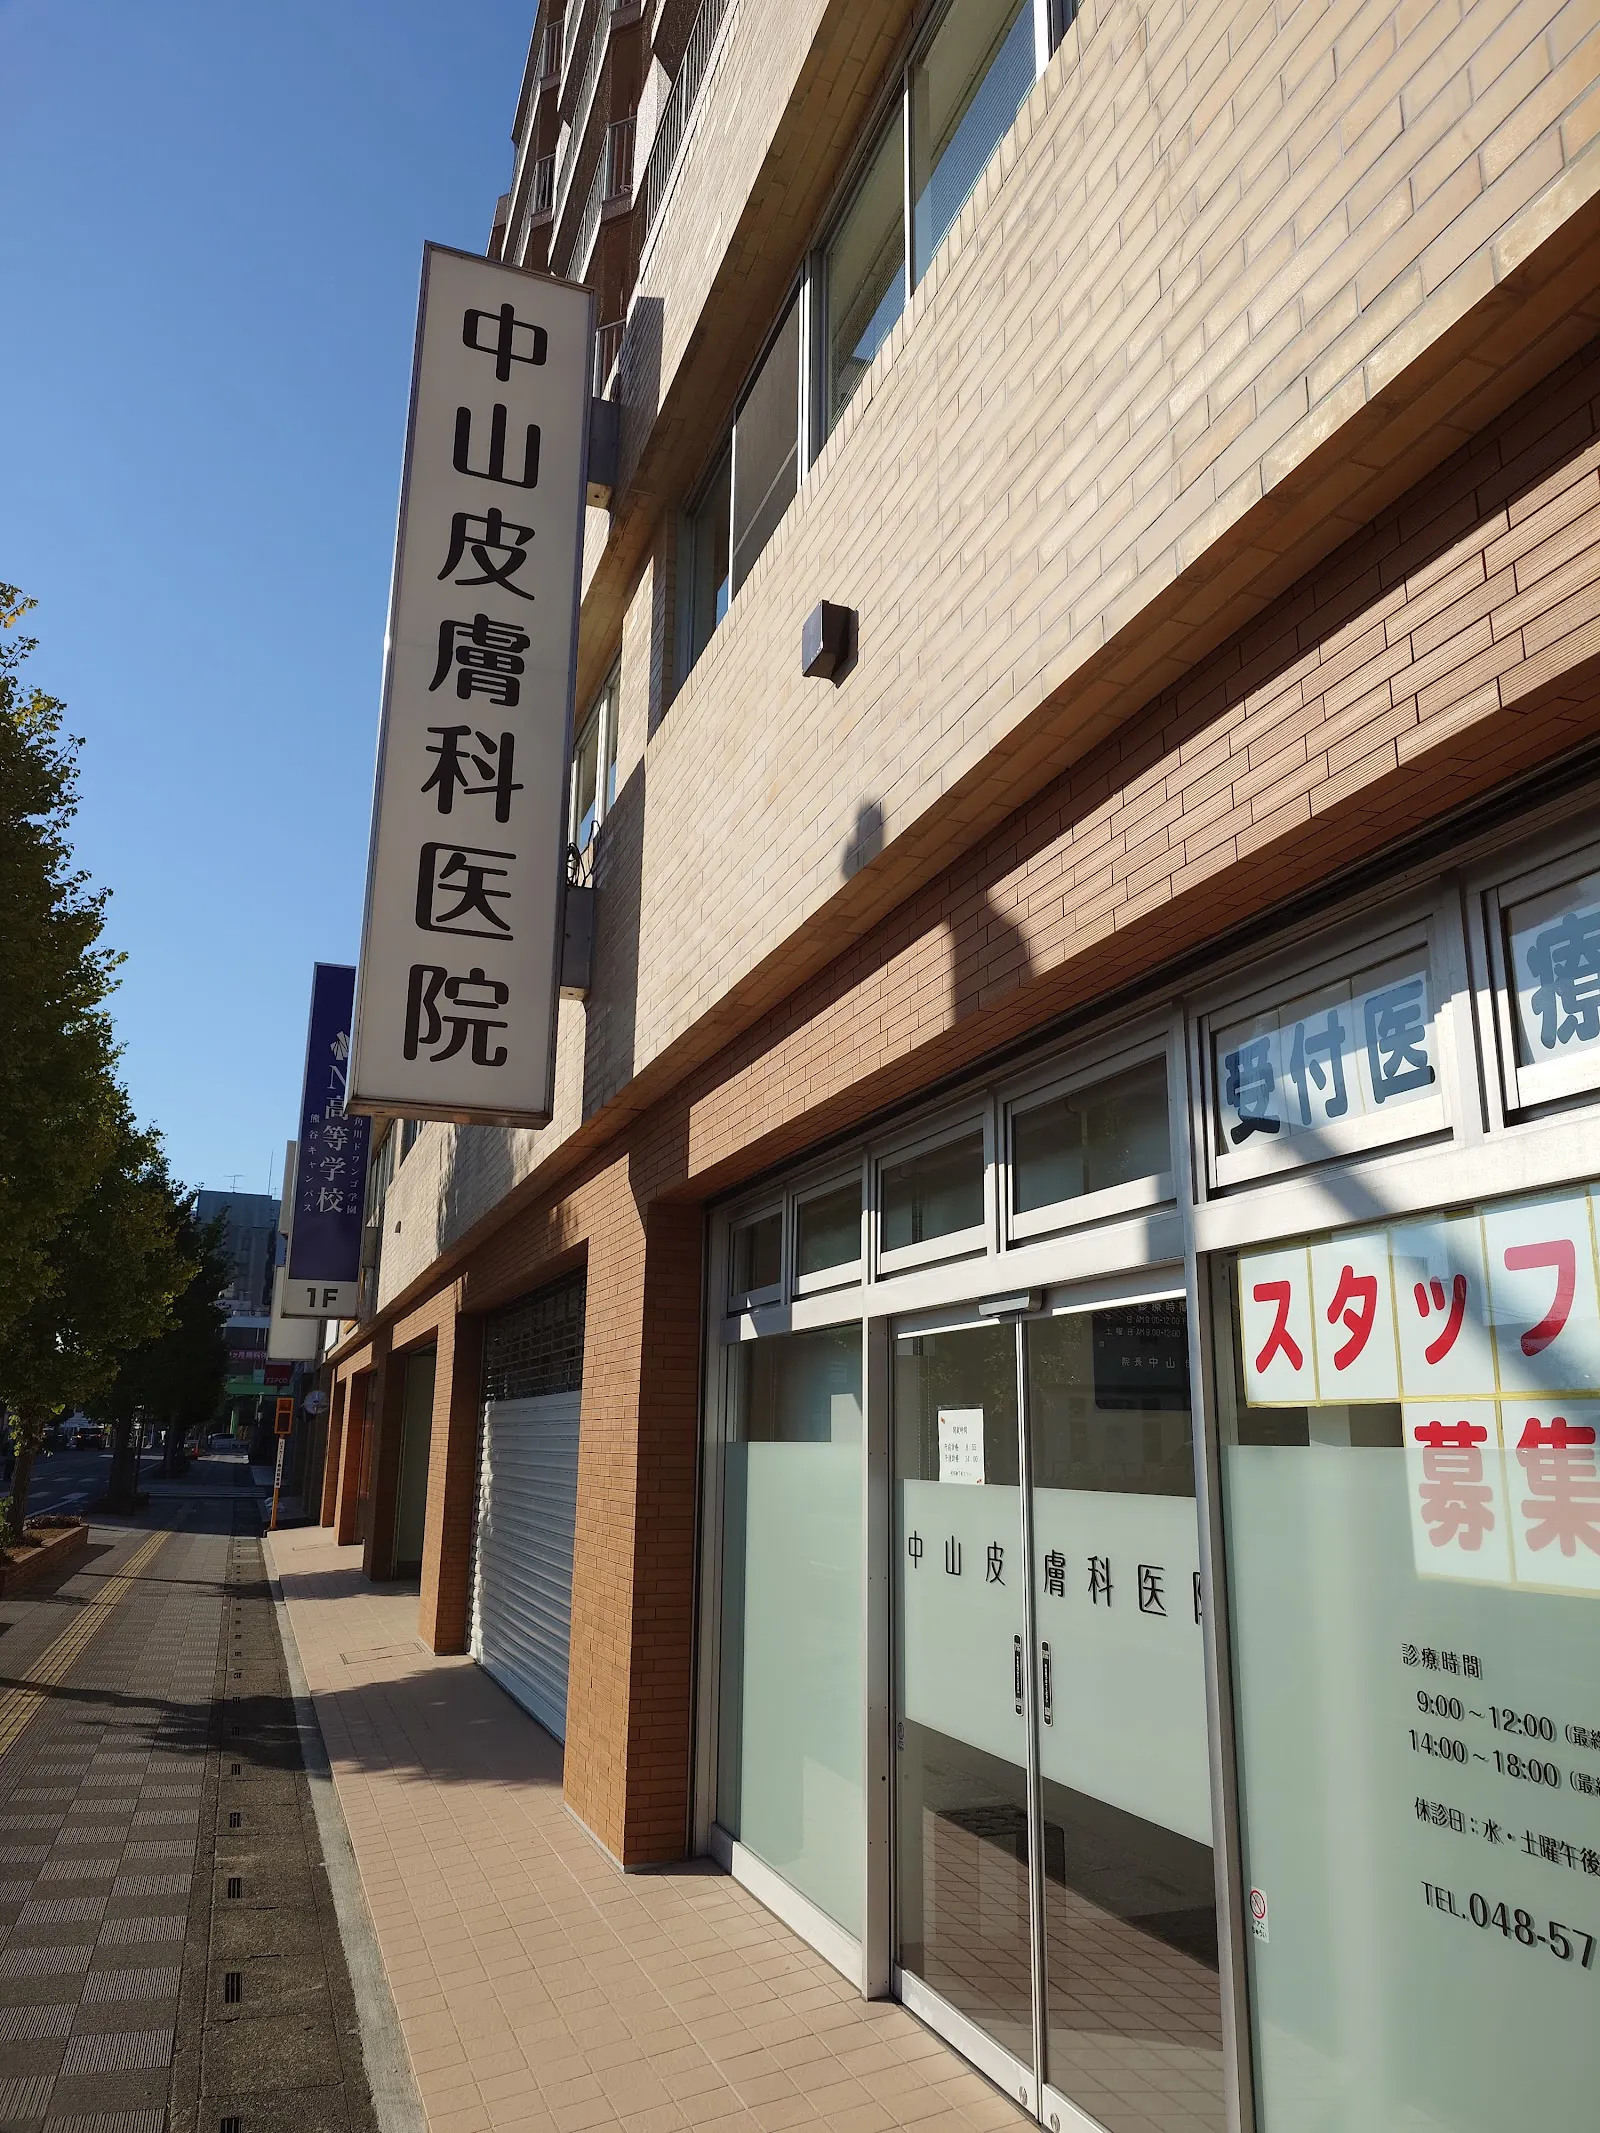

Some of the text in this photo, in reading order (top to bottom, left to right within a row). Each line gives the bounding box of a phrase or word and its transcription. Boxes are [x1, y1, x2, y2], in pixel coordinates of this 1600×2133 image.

[403, 303, 548, 1067] 中山皮膚科医院
[303, 1113, 320, 1212] 熊谷キャンパス
[316, 1065, 349, 1213] N高等学校
[346, 1116, 364, 1215] 角川ドワンゴ学園
[306, 1287, 339, 1308] 1F
[1252, 1239, 1576, 1374] スタッフ
[1414, 1416, 1600, 1557] 募集
[1402, 1642, 1482, 1679] 診療時間
